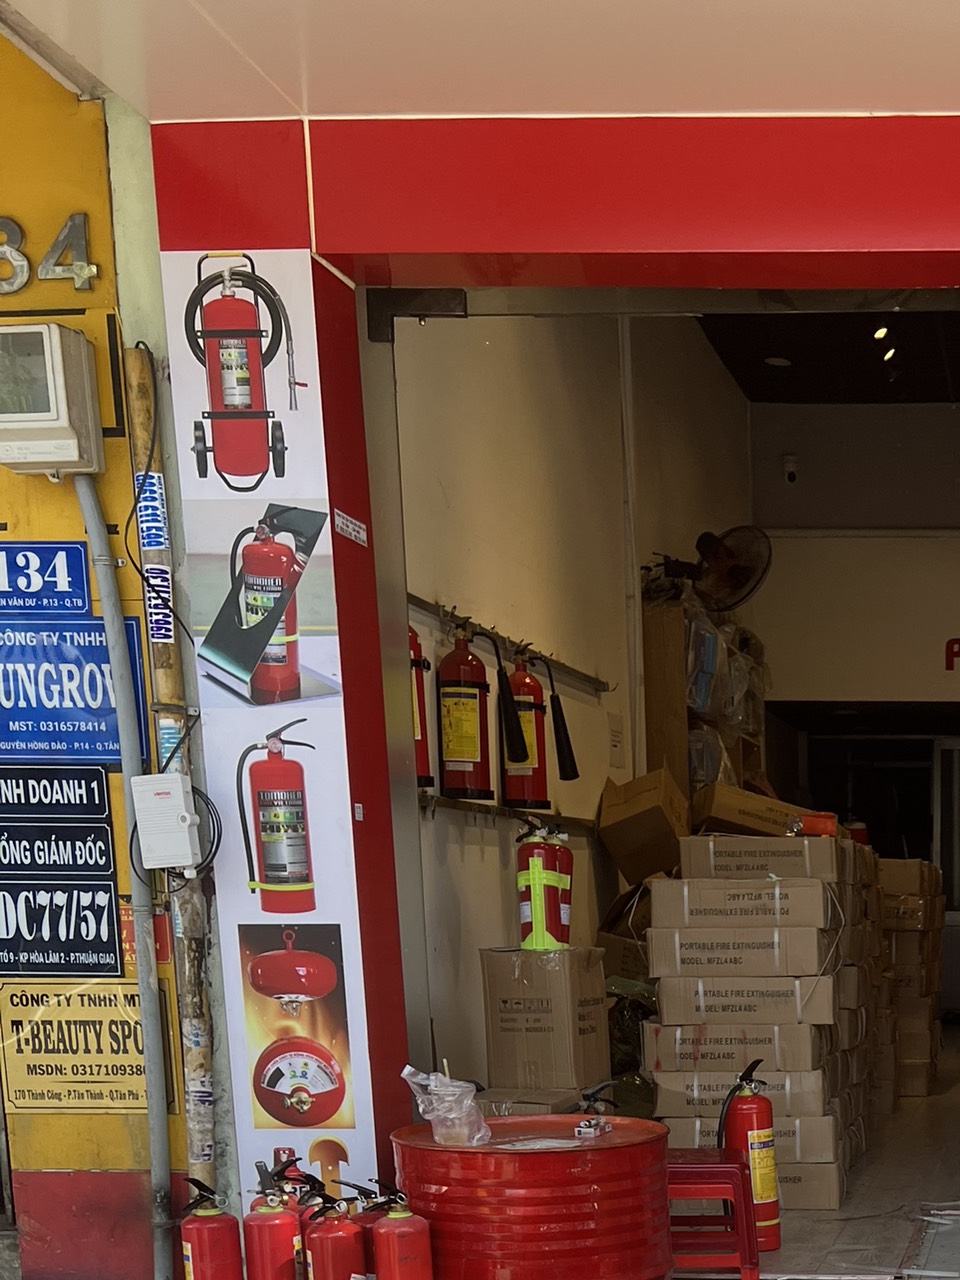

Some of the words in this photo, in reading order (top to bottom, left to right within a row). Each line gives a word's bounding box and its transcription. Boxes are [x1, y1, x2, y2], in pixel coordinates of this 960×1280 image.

[39, 632, 59, 646] TY
[0, 663, 117, 709] UNGRO
[9, 722, 37, 732] MST:
[28, 779, 87, 804] DOANH
[91, 780, 100, 804] 1
[0, 832, 31, 865] ỔNG
[34, 833, 73, 865] GIÁM
[75, 833, 106, 866] ĐỐC
[743, 850, 757, 858] FIRE
[680, 942, 715, 951] PORTABLE
[716, 942, 731, 950] FIRE
[680, 957, 706, 966] MODEL:
[10, 990, 50, 1007] CÔNG
[54, 993, 72, 1007] TY
[695, 990, 730, 998] PRTABLE
[731, 990, 745, 998] FIRE
[746, 990, 795, 998] EXTINGUISHER
[695, 1005, 720, 1013] MDEL:
[11, 1020, 103, 1056] T-BEAUTY
[108, 1019, 144, 1056] SPO
[709, 1037, 724, 1046] FIRE
[725, 1037, 773, 1046] EXTINGUISHER
[27, 1064, 67, 1076] MSDN:
